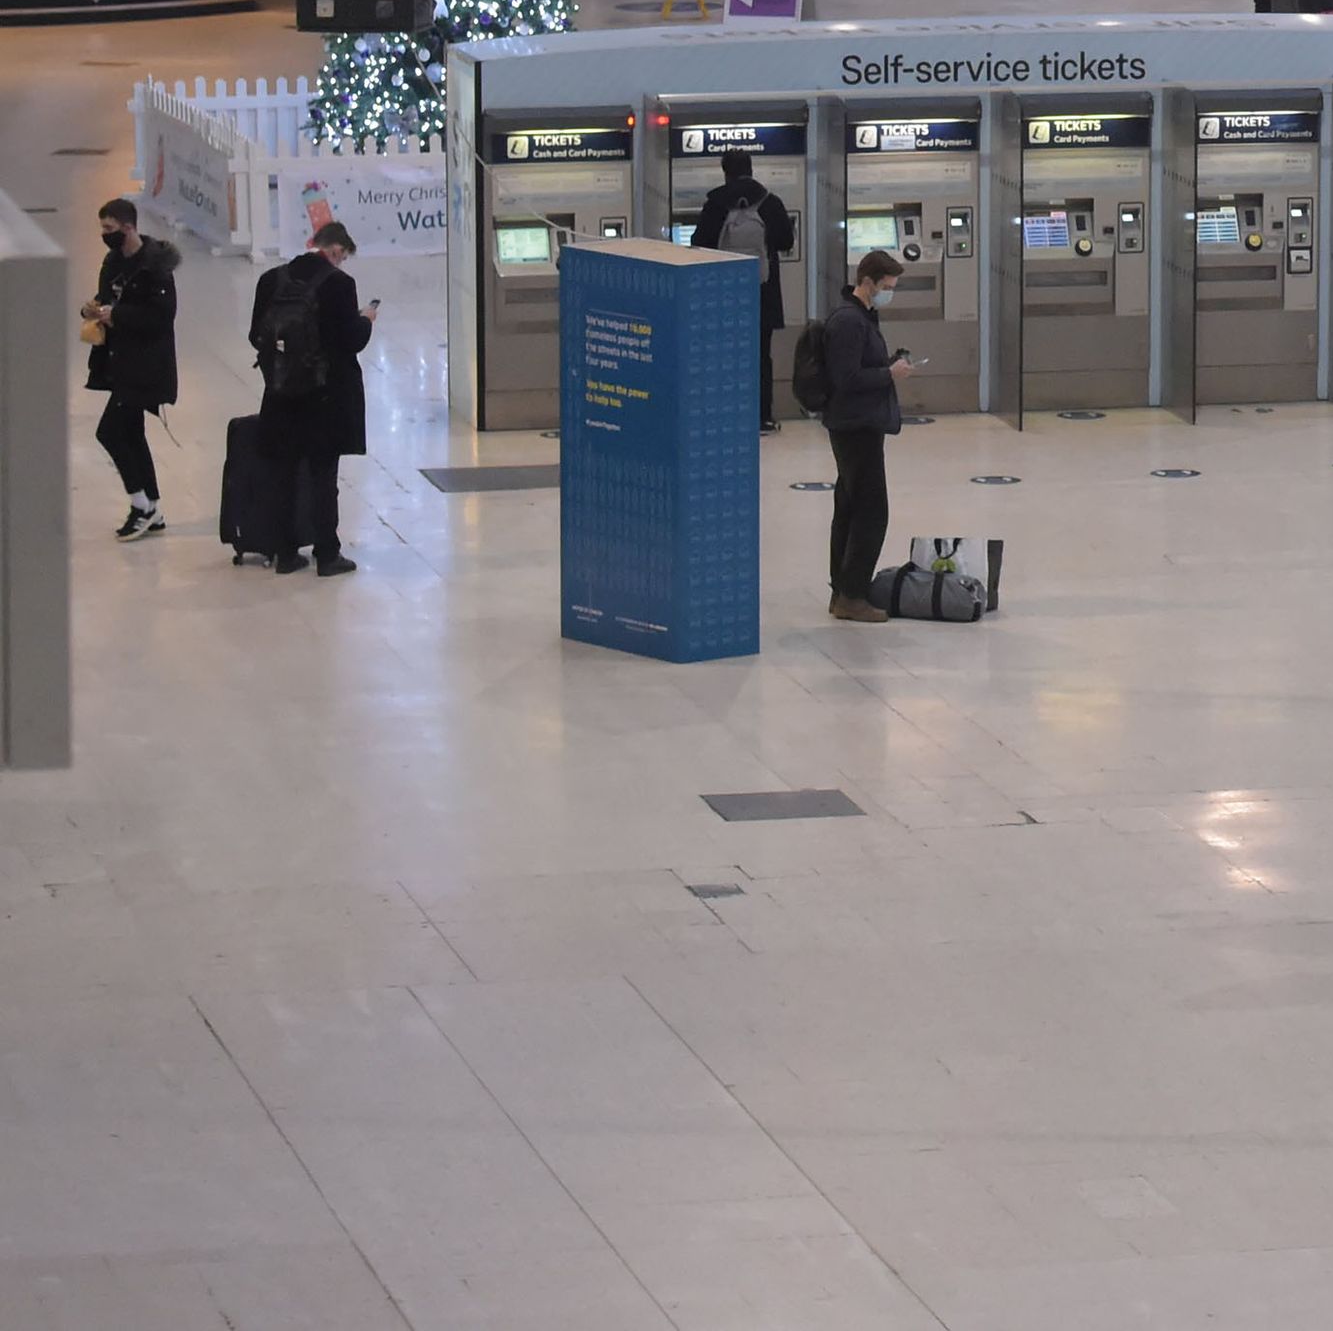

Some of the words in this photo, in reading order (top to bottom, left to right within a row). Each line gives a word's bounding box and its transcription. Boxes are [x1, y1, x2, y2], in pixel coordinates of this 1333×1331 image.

[841, 53, 1030, 87] Self-service
[1039, 51, 1147, 81] tickets
[1053, 120, 1102, 131] TICKETS
[1223, 115, 1271, 127] TICKETS
[707, 128, 756, 140] TICKETS
[881, 124, 929, 136] TICKETS
[1223, 130, 1241, 139] Cash
[1243, 130, 1257, 139] and
[1258, 130, 1275, 139] Card
[1276, 129, 1313, 140] Payments
[533, 134, 582, 146] TICKETS
[916, 138, 934, 148] Card
[935, 138, 972, 149] Payments
[1054, 134, 1071, 144] Card
[1072, 134, 1109, 145] Payments
[533, 148, 551, 158] Cash
[552, 148, 567, 158] and
[568, 148, 586, 159] Card
[587, 147, 625, 159] Payments
[707, 142, 725, 152] Card
[358, 189, 403, 207] Merry
[398, 211, 446, 231] Wat
